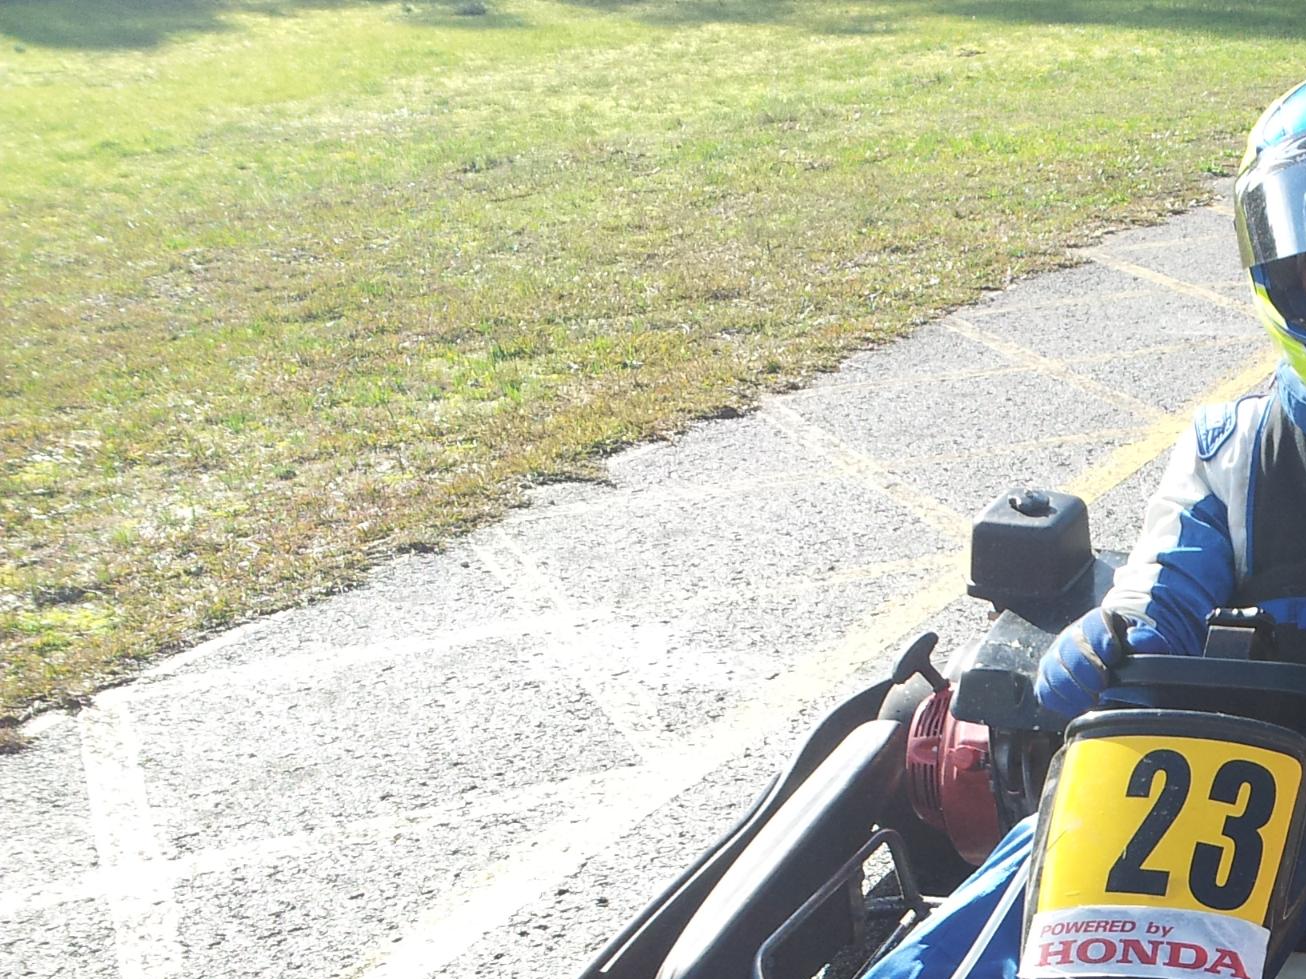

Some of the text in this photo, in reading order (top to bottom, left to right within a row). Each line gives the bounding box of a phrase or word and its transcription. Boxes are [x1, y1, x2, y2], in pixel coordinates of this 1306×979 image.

[1104, 748, 1277, 911] 23
[1040, 919, 1174, 938] POWERED by
